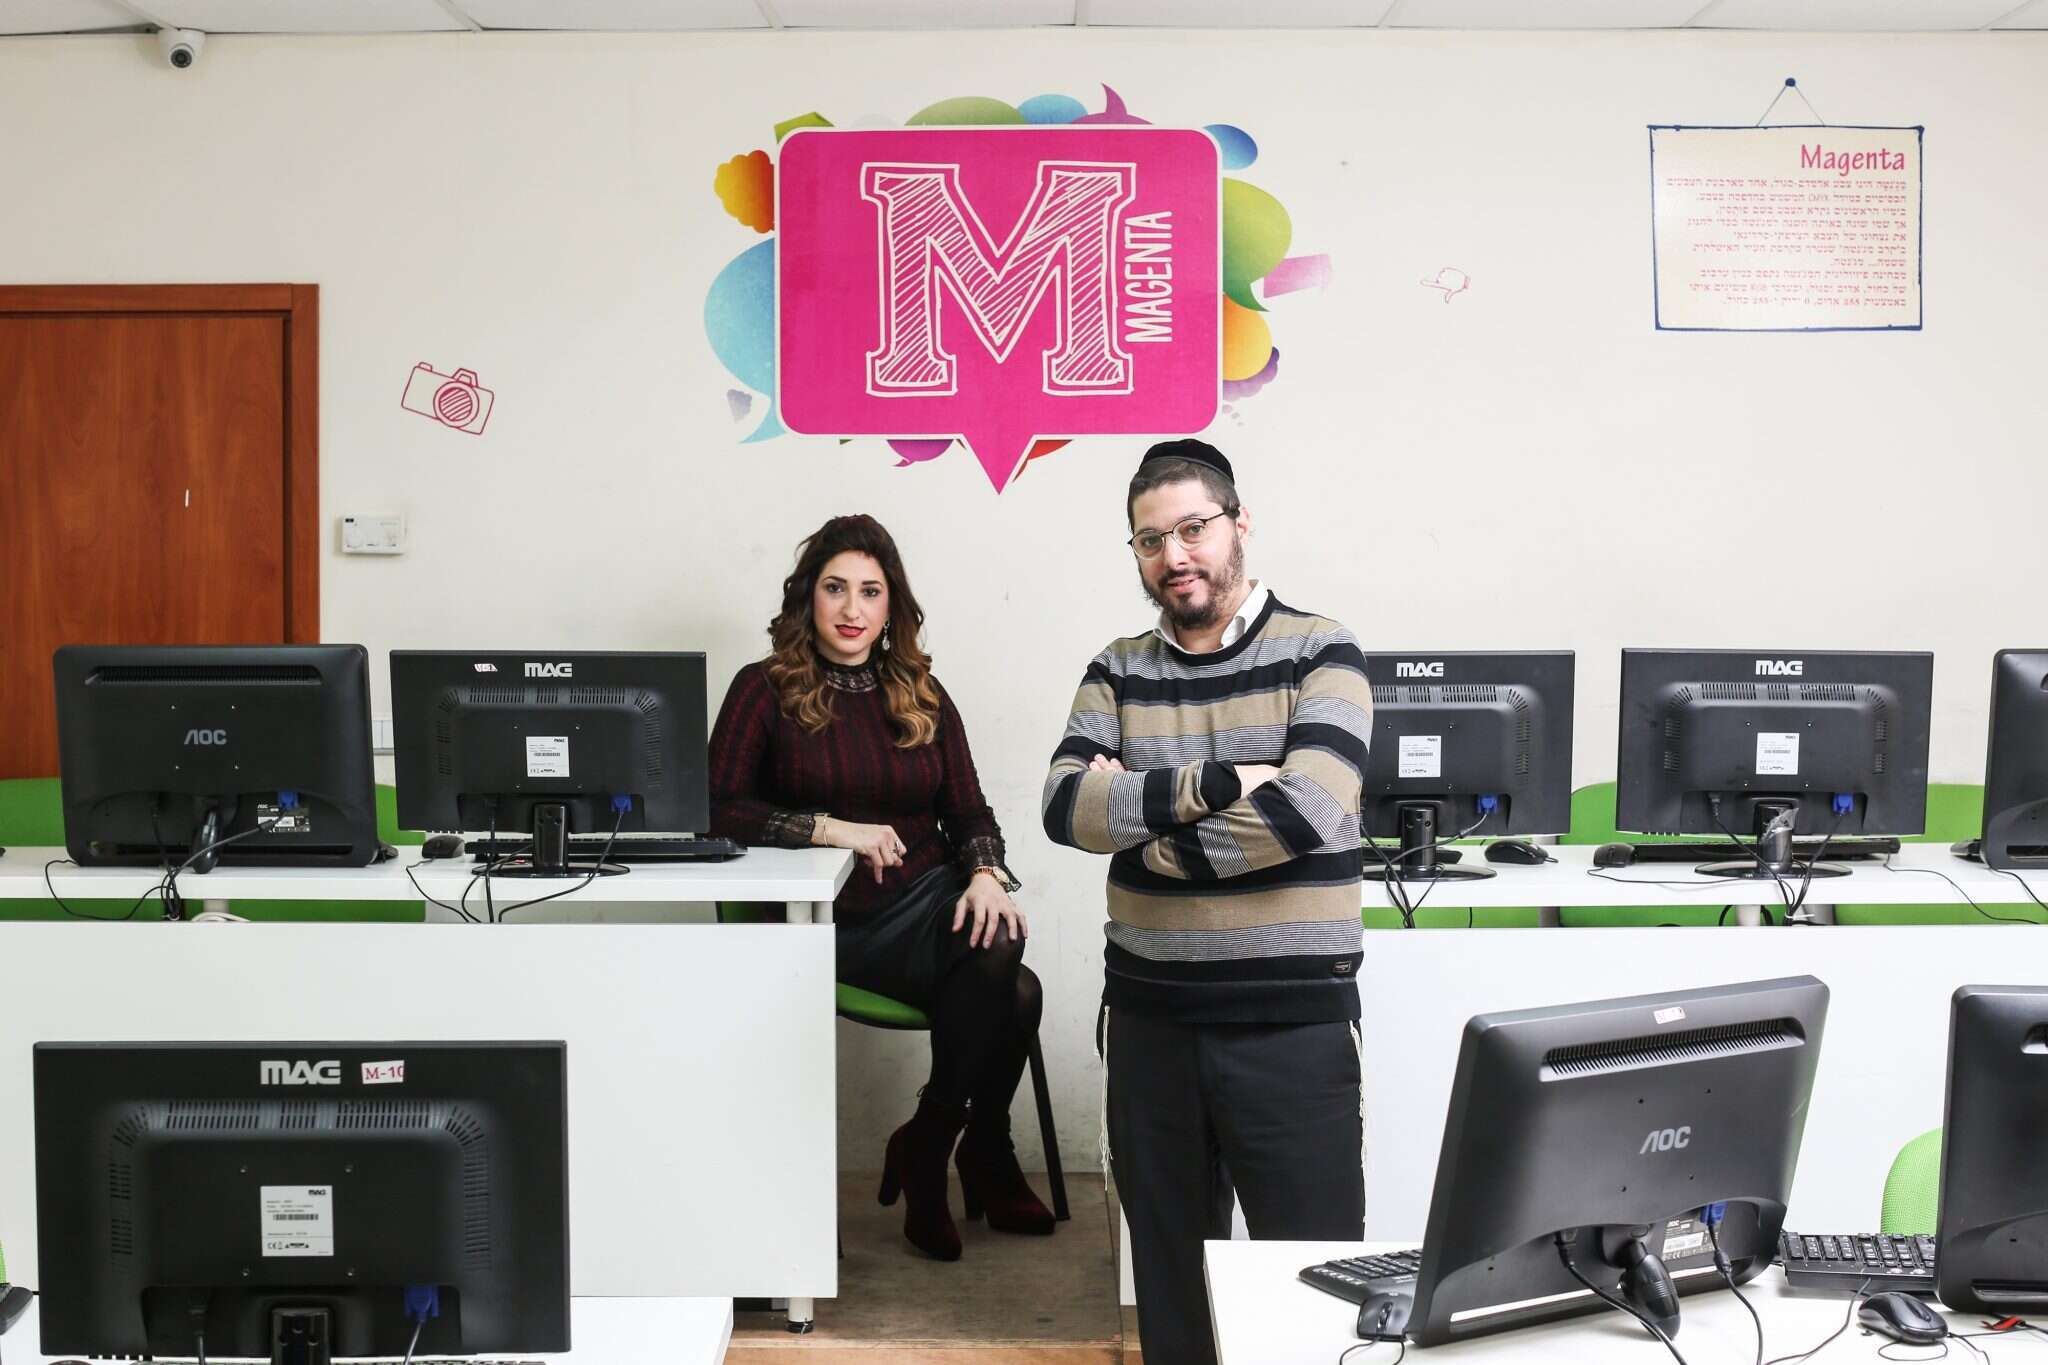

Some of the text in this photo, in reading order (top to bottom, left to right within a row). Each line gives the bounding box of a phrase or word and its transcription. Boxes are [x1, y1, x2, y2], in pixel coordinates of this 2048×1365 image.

[1801, 144, 1905, 176] Magenta
[860, 161, 1137, 396] M
[1125, 211, 1173, 343] MAGENTA
[524, 662, 573, 678] MAG
[1396, 662, 1444, 677] MAG
[1756, 660, 1803, 675] MAG
[184, 729, 227, 745] AOC
[260, 1060, 341, 1085] MAG
[1640, 1126, 1691, 1154] AOC
